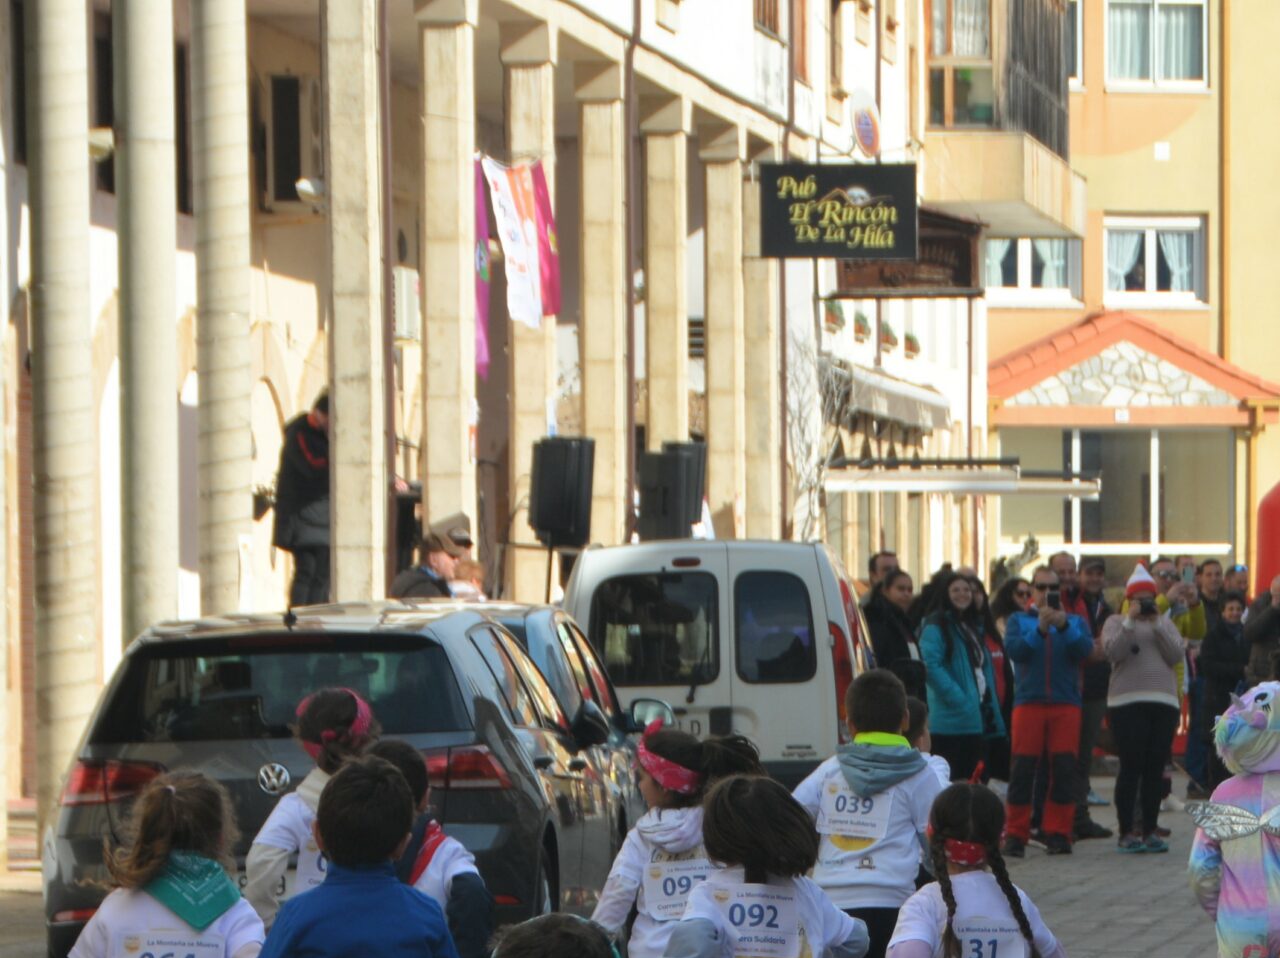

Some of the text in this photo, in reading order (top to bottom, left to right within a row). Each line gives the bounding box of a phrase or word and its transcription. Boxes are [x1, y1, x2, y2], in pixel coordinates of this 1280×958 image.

[777, 175, 817, 199] Pub
[789, 200, 898, 227] El Rincón
[795, 223, 896, 249] De La Hila
[835, 795, 874, 815] 039
[729, 903, 779, 928] 092
